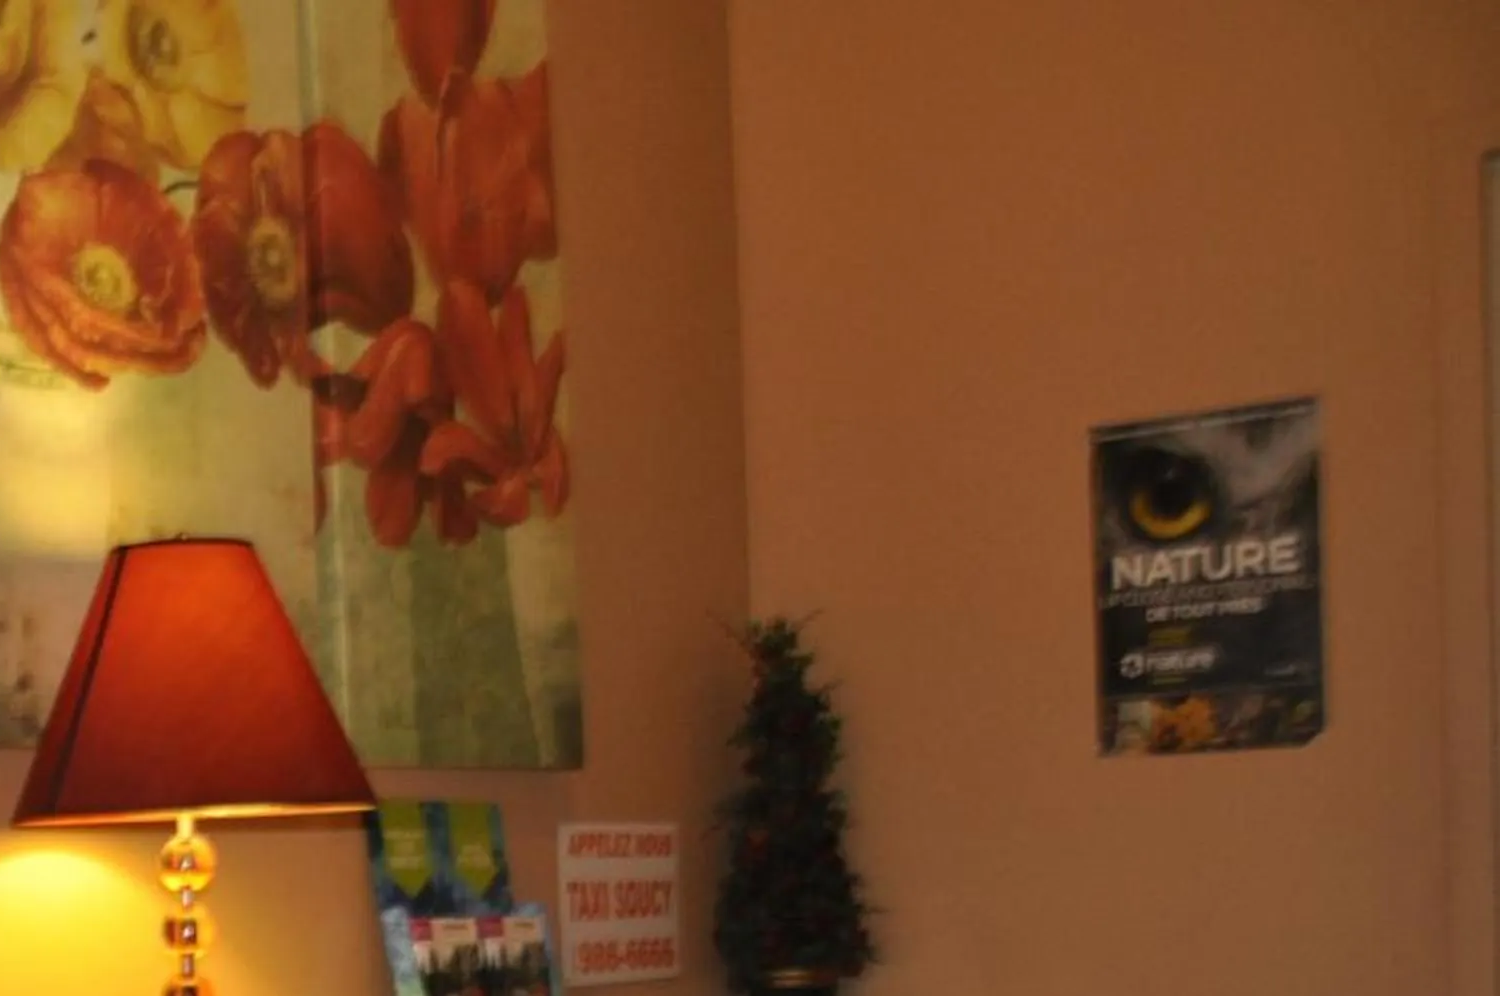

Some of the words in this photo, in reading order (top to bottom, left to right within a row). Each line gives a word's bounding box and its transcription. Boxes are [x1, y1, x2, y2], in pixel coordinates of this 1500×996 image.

[1110, 534, 1300, 591] NATURE
[567, 832, 631, 858] APPELEZ
[566, 880, 609, 922] TAXI
[614, 879, 673, 919] SOUCY
